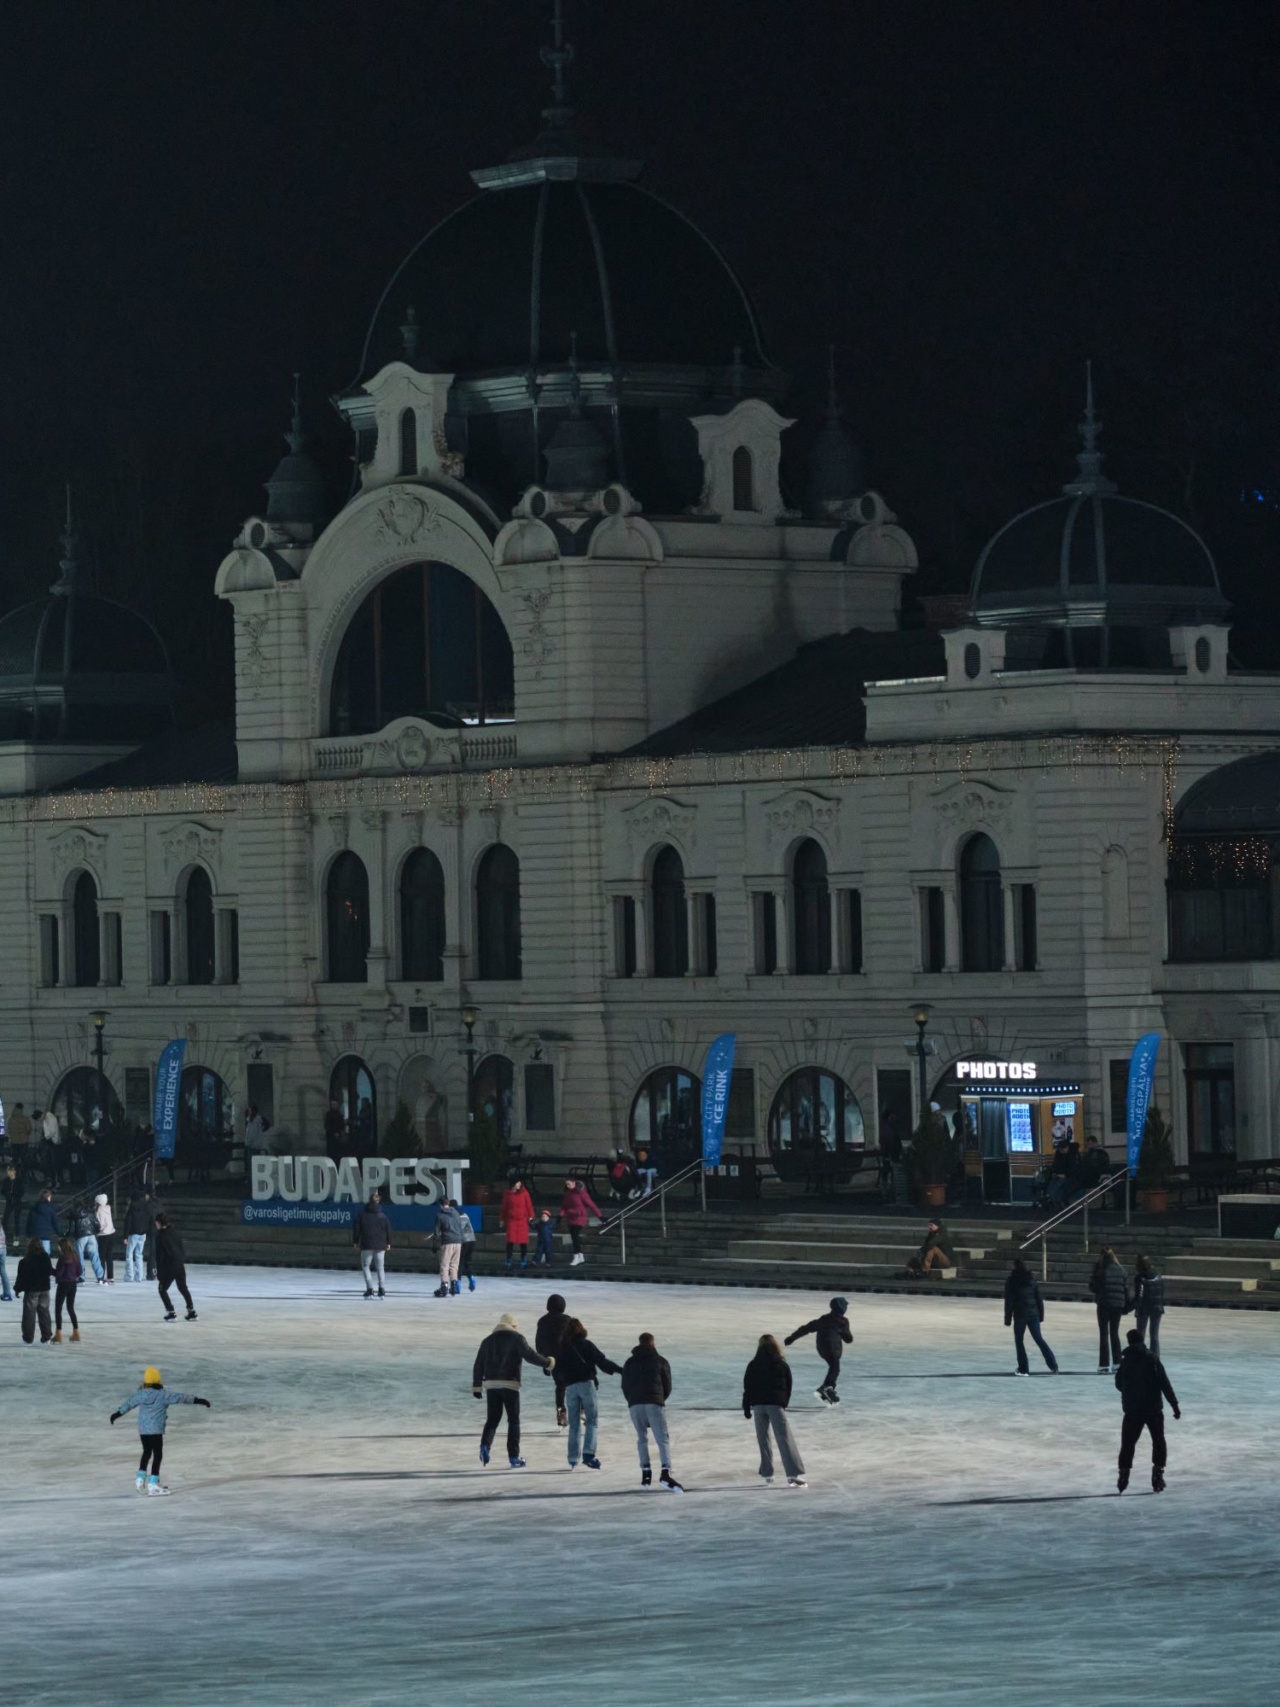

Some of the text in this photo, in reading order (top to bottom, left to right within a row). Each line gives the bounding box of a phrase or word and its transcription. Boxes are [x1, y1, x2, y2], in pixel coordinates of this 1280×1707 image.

[155, 1067, 166, 1120] SHARE YOUR
[163, 1059, 179, 1129] EXPERIENCE
[705, 1073, 715, 1119] CITY PARK
[956, 1062, 1037, 1079] PHOTOS
[714, 1070, 728, 1123] ICE RINK
[251, 1155, 470, 1206] BUDAPEST
[243, 1205, 351, 1224] @varosligetimujegpalya
